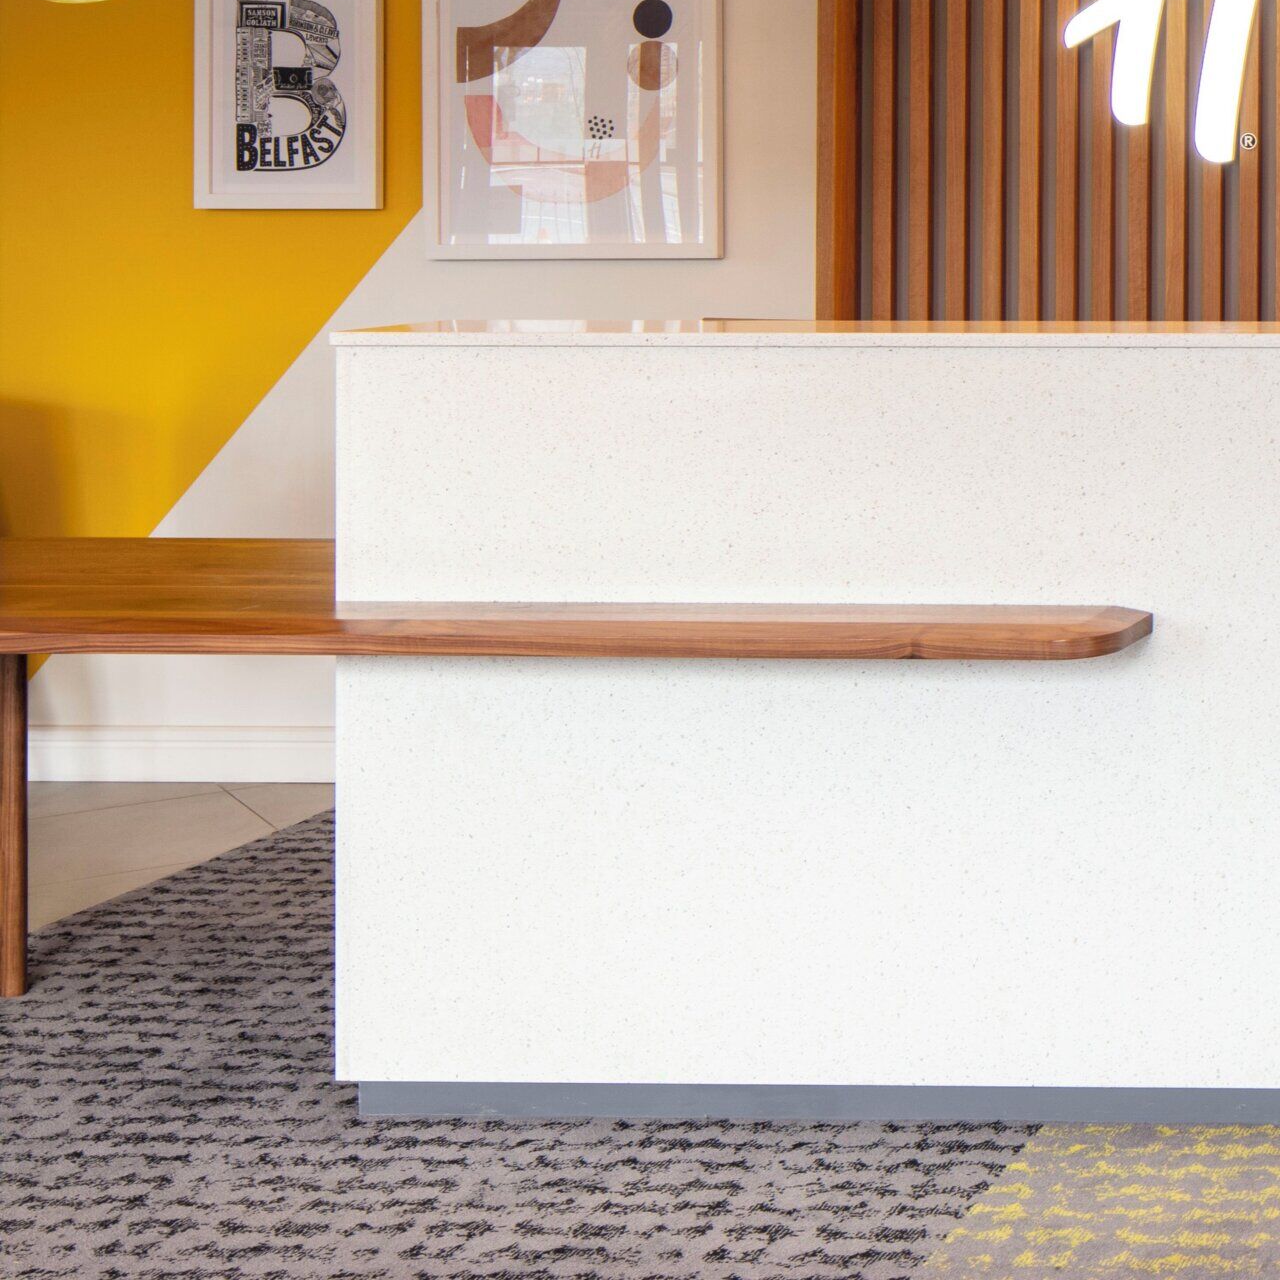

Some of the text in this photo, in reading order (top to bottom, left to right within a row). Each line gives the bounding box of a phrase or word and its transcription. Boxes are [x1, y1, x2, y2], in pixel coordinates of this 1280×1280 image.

[247, 10, 277, 18] SAMSON
[246, 20, 277, 28] GOLIATH
[236, 115, 342, 172] BELFAST
